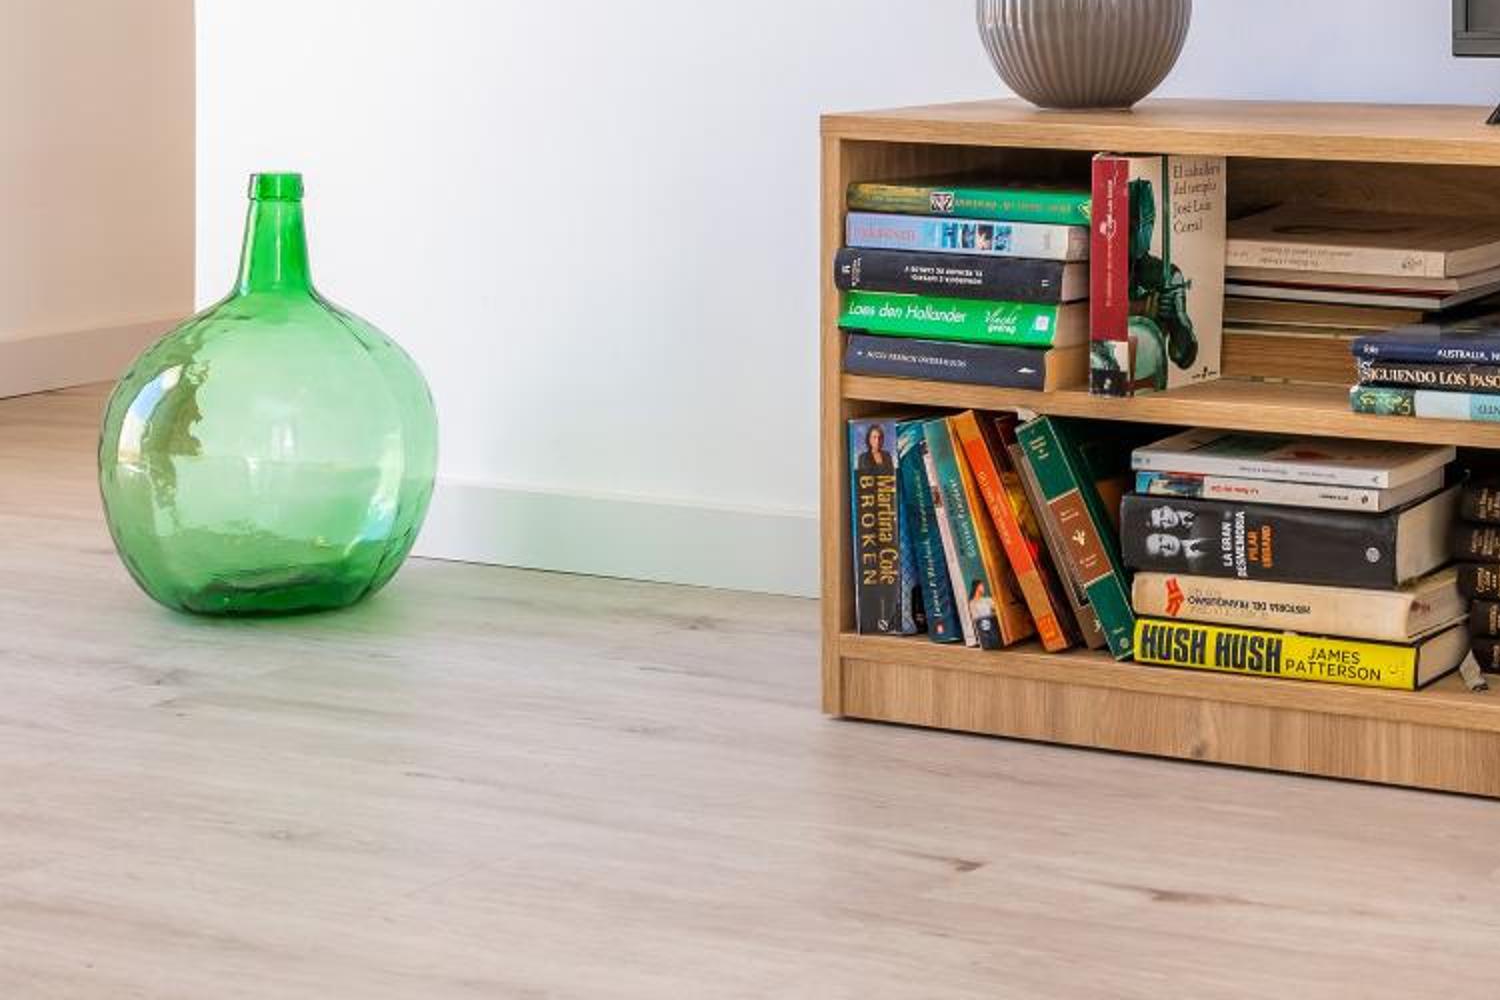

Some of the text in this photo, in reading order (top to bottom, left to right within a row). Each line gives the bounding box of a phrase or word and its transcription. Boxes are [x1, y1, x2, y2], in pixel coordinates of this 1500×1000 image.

[879, 302, 903, 319] den
[905, 304, 967, 324] Hollander
[1361, 366, 1436, 384] SIGUIENDO
[1439, 370, 1468, 386] LOS
[859, 475, 878, 586] BROKEN
[877, 475, 898, 585] Martina Cole
[1221, 521, 1233, 567] LA GRAN
[1251, 600, 1268, 612] DEL
[1139, 623, 1284, 676] HUSH HUSH
[1306, 646, 1362, 665] JAMES
[1284, 659, 1383, 682] PATTERSON
